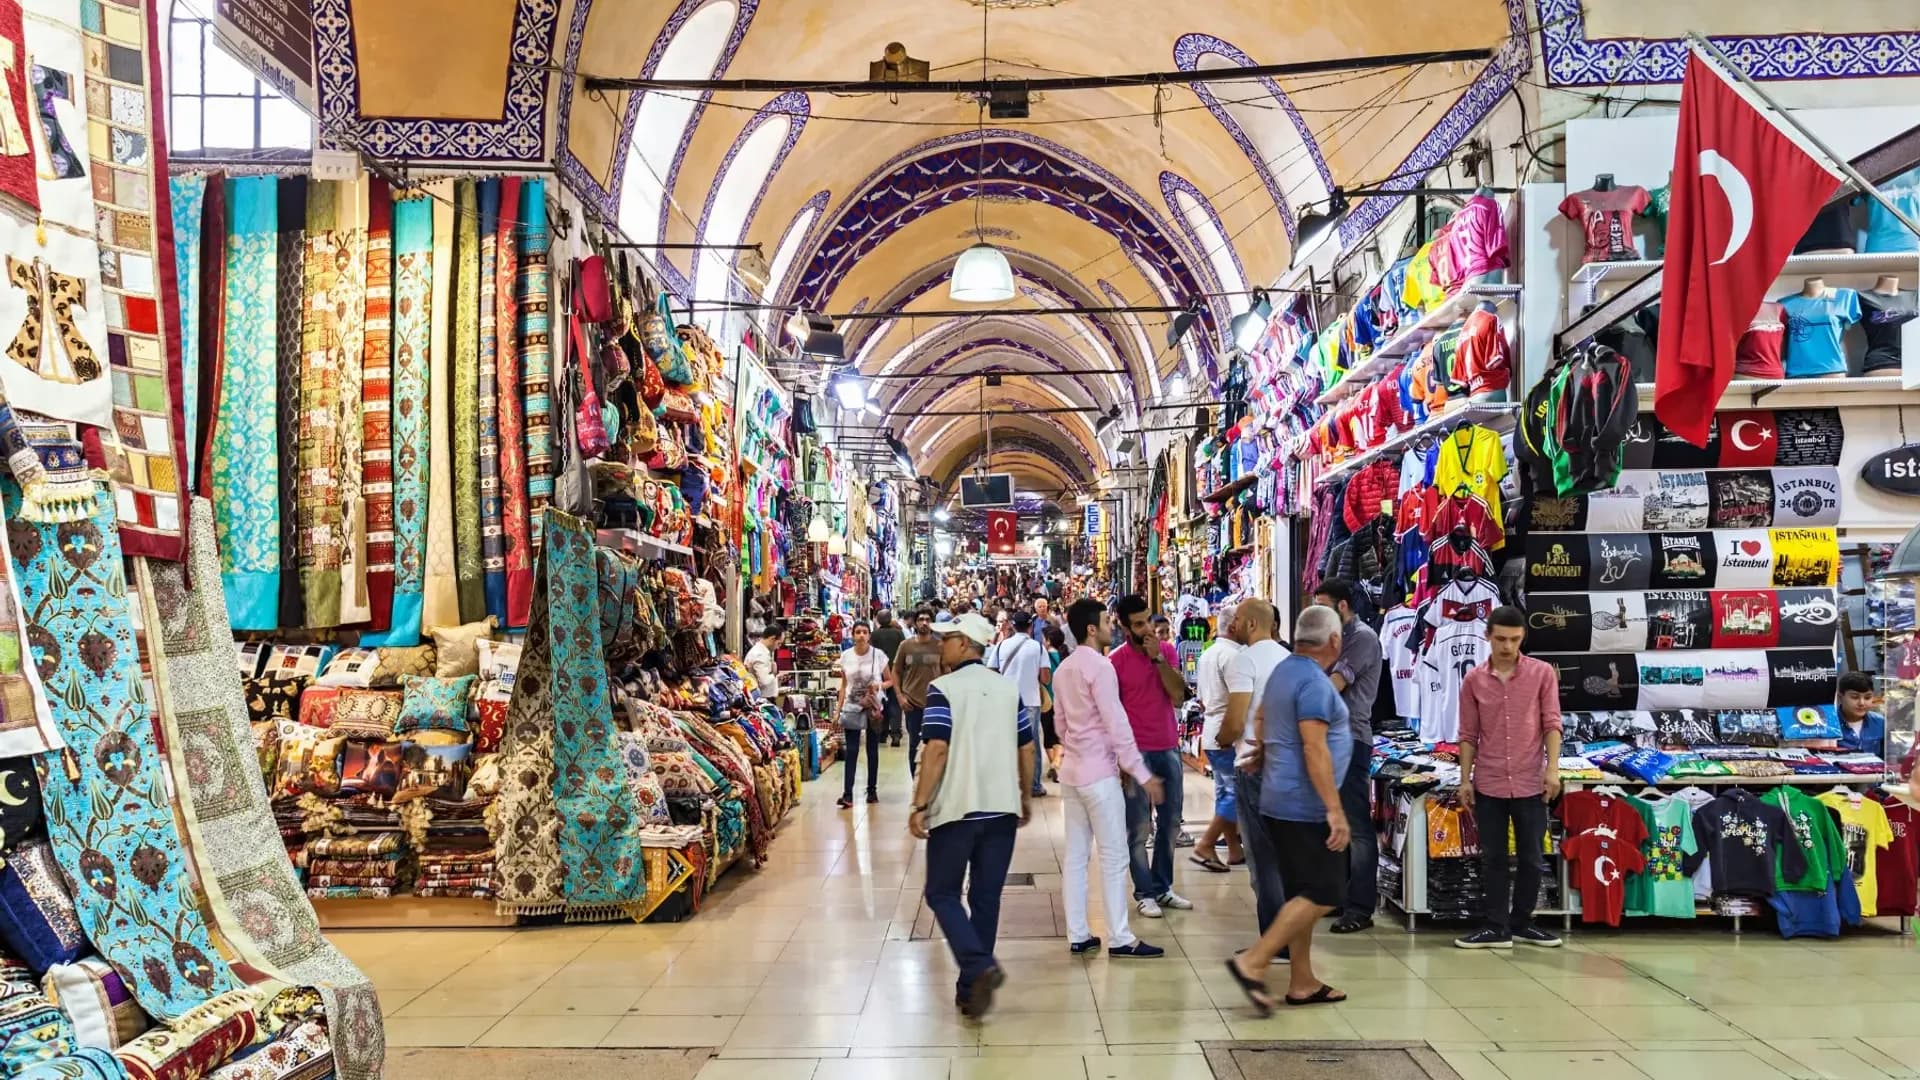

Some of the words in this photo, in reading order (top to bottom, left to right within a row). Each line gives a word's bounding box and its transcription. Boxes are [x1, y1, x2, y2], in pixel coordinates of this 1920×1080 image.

[1884, 457, 1920, 478] ist
[1780, 499, 1792, 508] 34
[1823, 499, 1836, 508] TR
[1730, 540, 1740, 556] I
